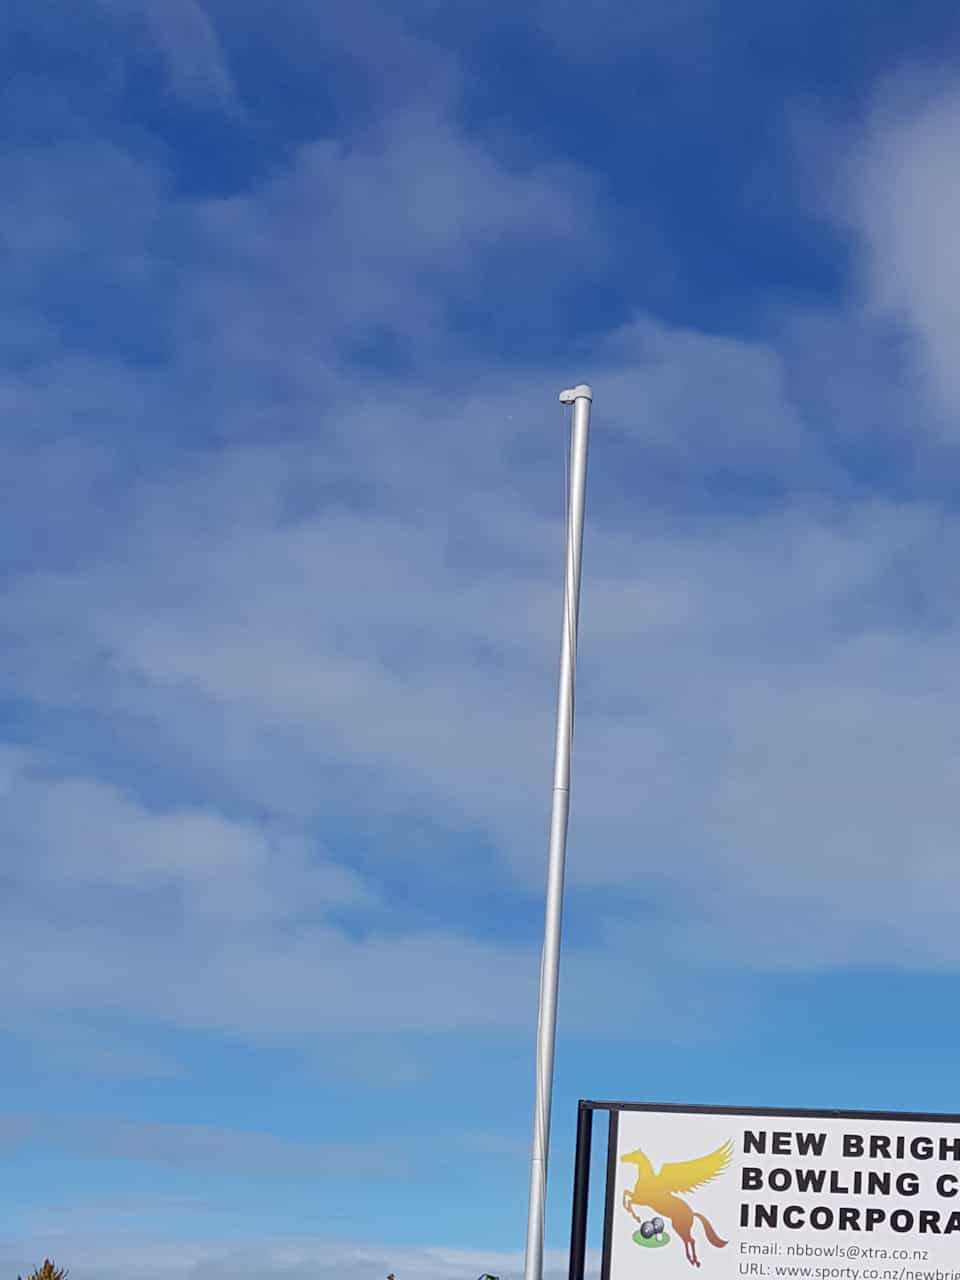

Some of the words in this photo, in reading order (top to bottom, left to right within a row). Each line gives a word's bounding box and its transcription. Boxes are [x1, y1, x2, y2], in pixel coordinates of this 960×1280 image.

[744, 1131, 826, 1156] NEW
[742, 1168, 919, 1196] BOWLING
[740, 1241, 782, 1255] Email:
[788, 1244, 928, 1260] nbbowls@xtra.co.nz
[739, 1262, 770, 1276] URL:
